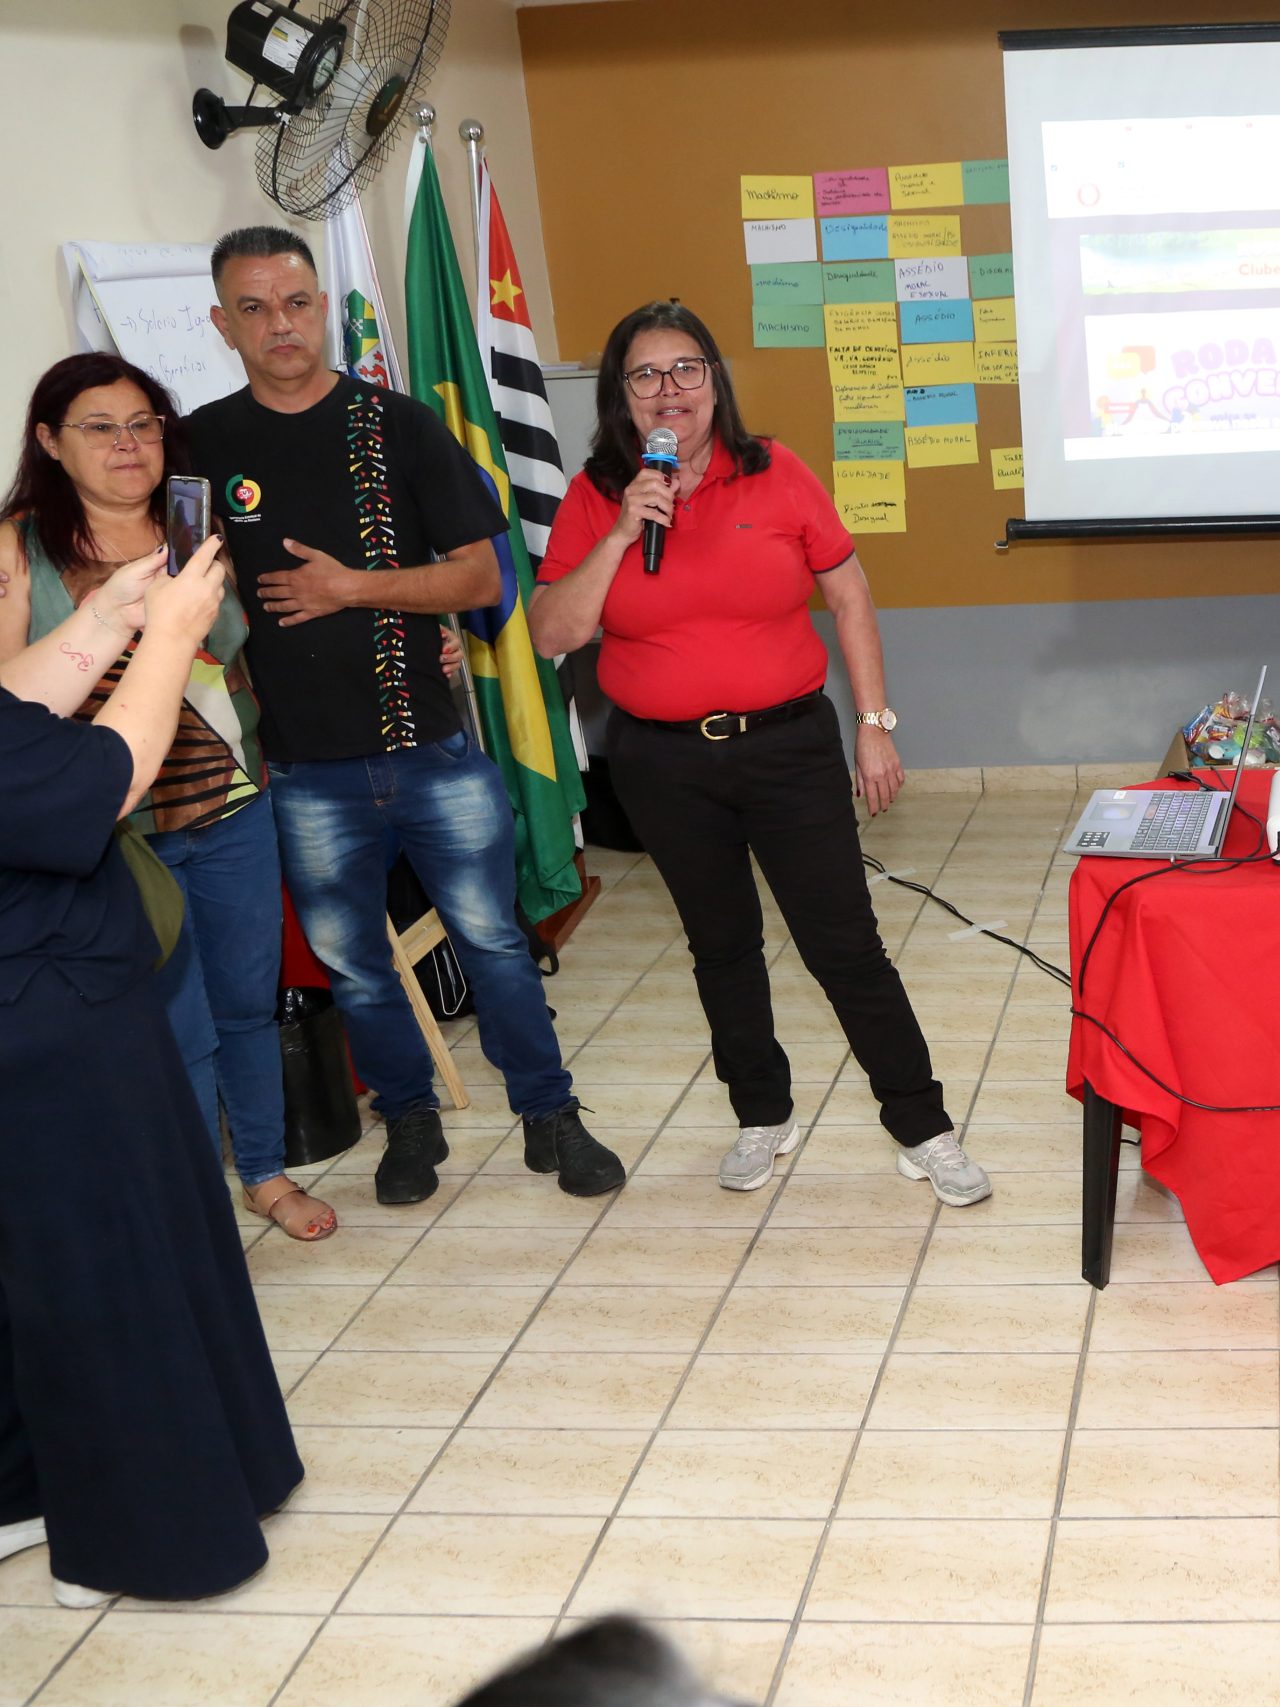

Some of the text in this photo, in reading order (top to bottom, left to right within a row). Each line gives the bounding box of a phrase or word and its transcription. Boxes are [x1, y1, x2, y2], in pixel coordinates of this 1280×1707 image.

[1238, 262, 1280, 276] Clube
[1171, 338, 1276, 379] RODA
[837, 469, 891, 481] IGUALDADE
